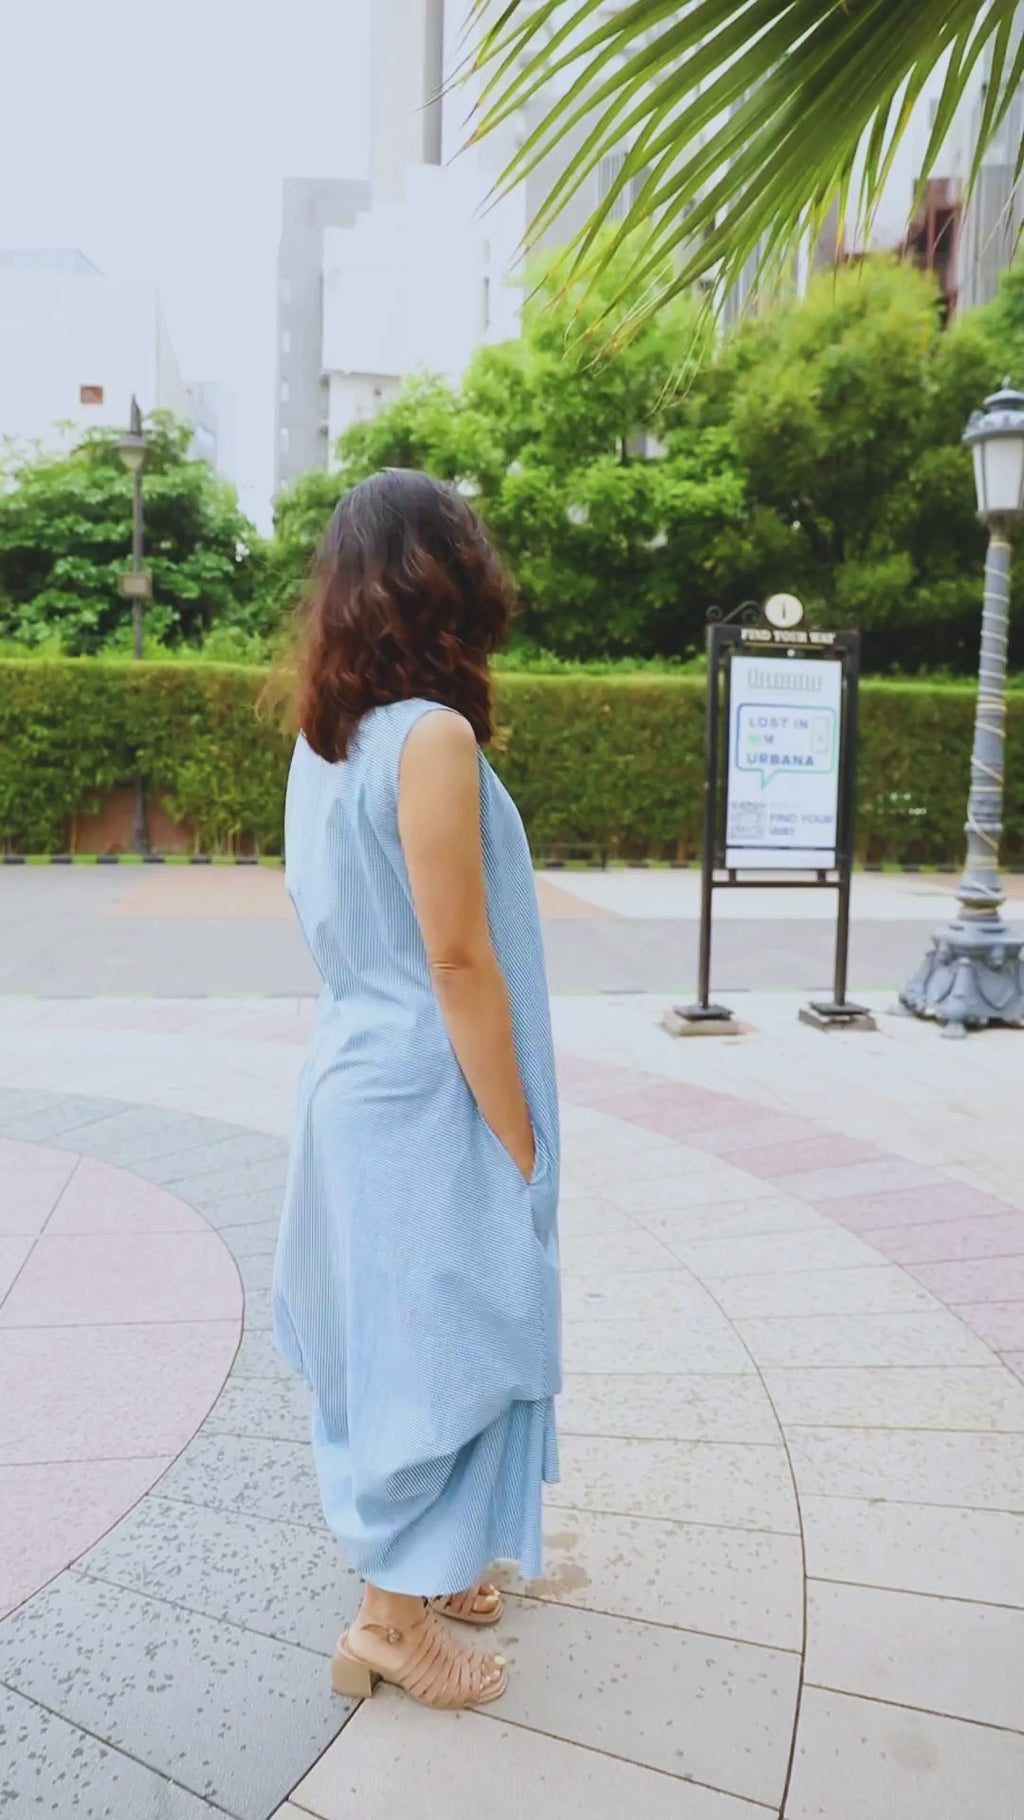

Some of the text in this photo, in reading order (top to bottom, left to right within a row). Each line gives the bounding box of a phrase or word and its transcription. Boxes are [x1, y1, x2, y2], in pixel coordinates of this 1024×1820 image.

[741, 628, 836, 645] FIND YOUR WAY
[748, 717, 809, 729] LOST IN
[746, 753, 814, 766] URBANA
